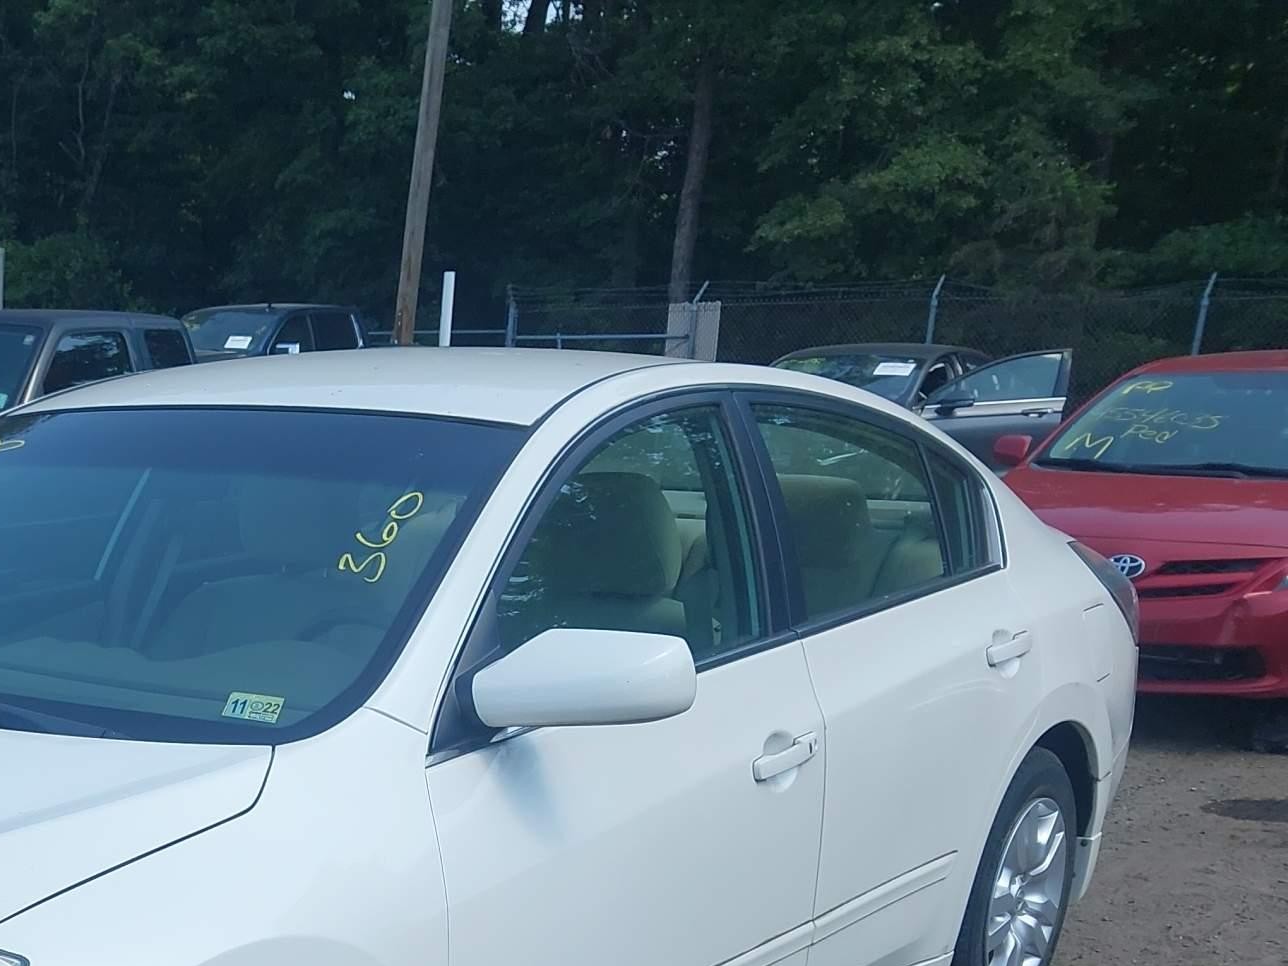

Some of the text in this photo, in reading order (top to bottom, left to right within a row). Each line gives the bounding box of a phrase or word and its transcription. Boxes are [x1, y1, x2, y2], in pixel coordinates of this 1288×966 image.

[1064, 432, 1115, 460] M
[338, 491, 423, 582] 360
[231, 698, 281, 715] 11 22
